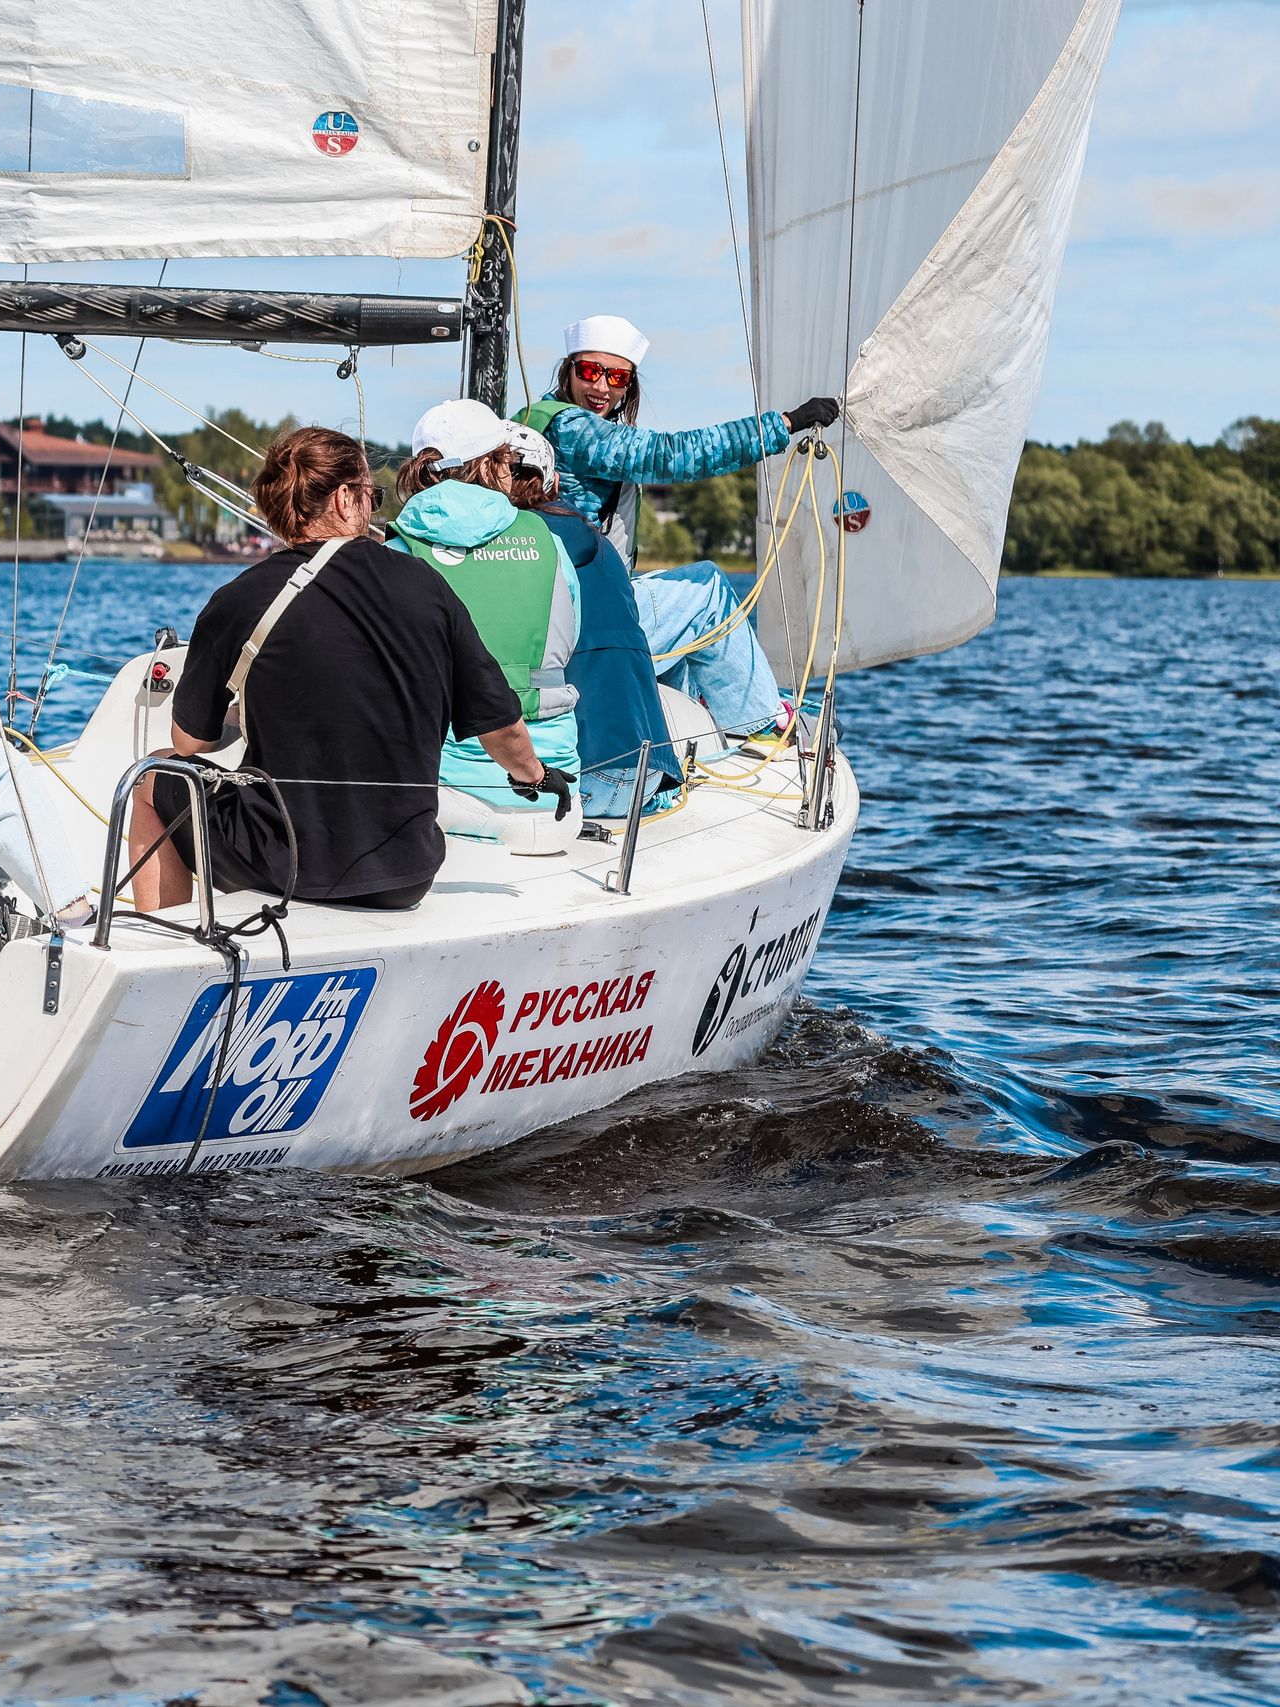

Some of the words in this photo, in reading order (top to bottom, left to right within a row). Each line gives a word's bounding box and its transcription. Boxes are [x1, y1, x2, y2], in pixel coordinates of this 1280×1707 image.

[328, 113, 346, 130] U
[327, 136, 342, 154] S
[482, 259, 493, 282] 3
[843, 493, 858, 510] U
[847, 513, 862, 531] S
[472, 547, 540, 561] RiverClub
[508, 970, 656, 1034] РУССКАЯ
[479, 1025, 654, 1095] МЕХАНИКА
[228, 1079, 313, 1135] OIL
[193, 1146, 292, 1172] материалы
